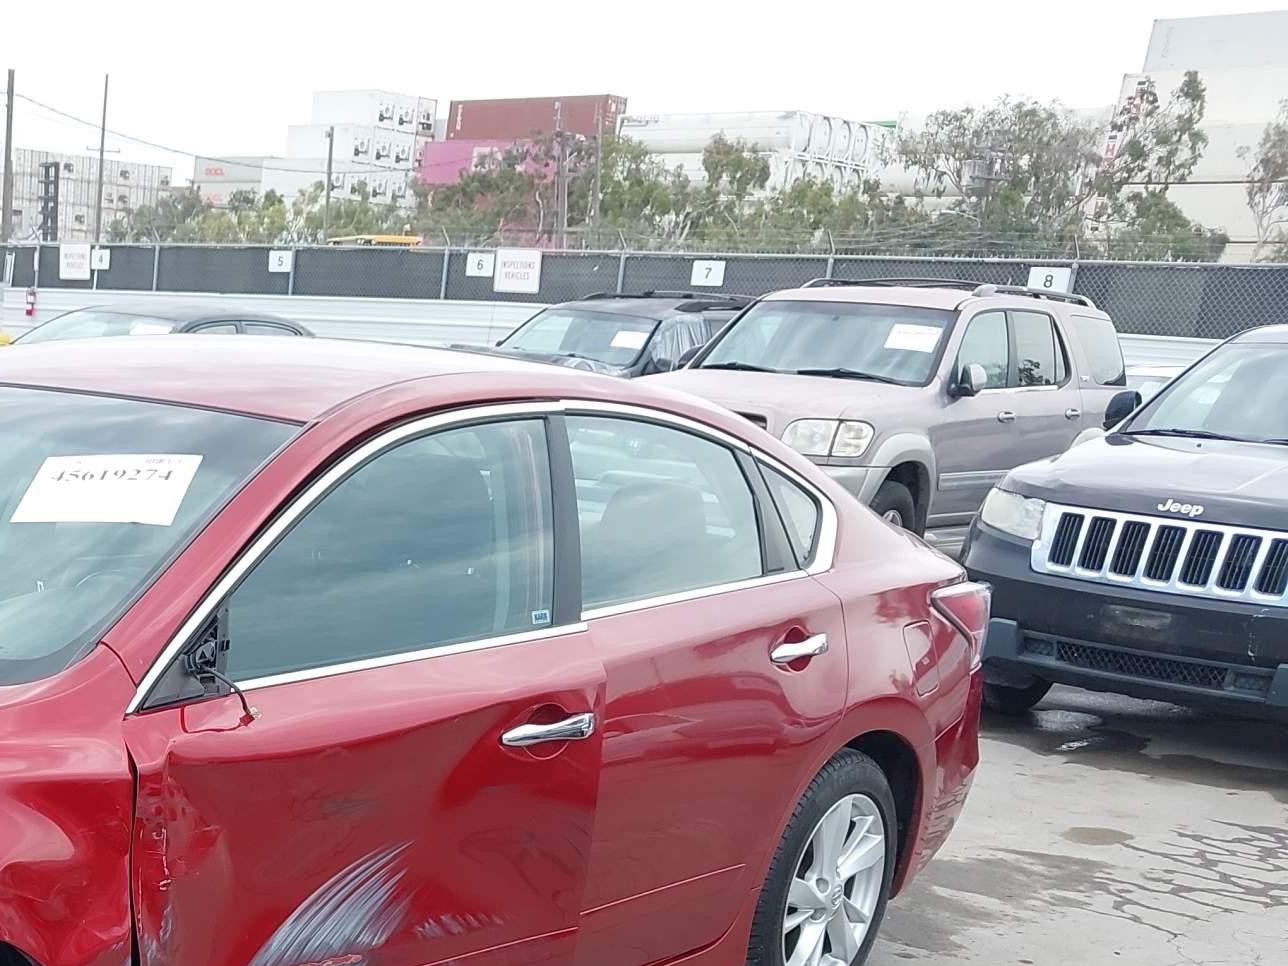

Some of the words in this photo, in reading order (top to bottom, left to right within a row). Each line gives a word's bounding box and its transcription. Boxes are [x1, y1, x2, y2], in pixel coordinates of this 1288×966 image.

[278, 256, 284, 267] 5
[477, 259, 484, 270] 6
[705, 267, 712, 279] 7
[1043, 274, 1053, 288] 8
[51, 469, 173, 481] 45619274
[1157, 498, 1204, 517] Jeep
